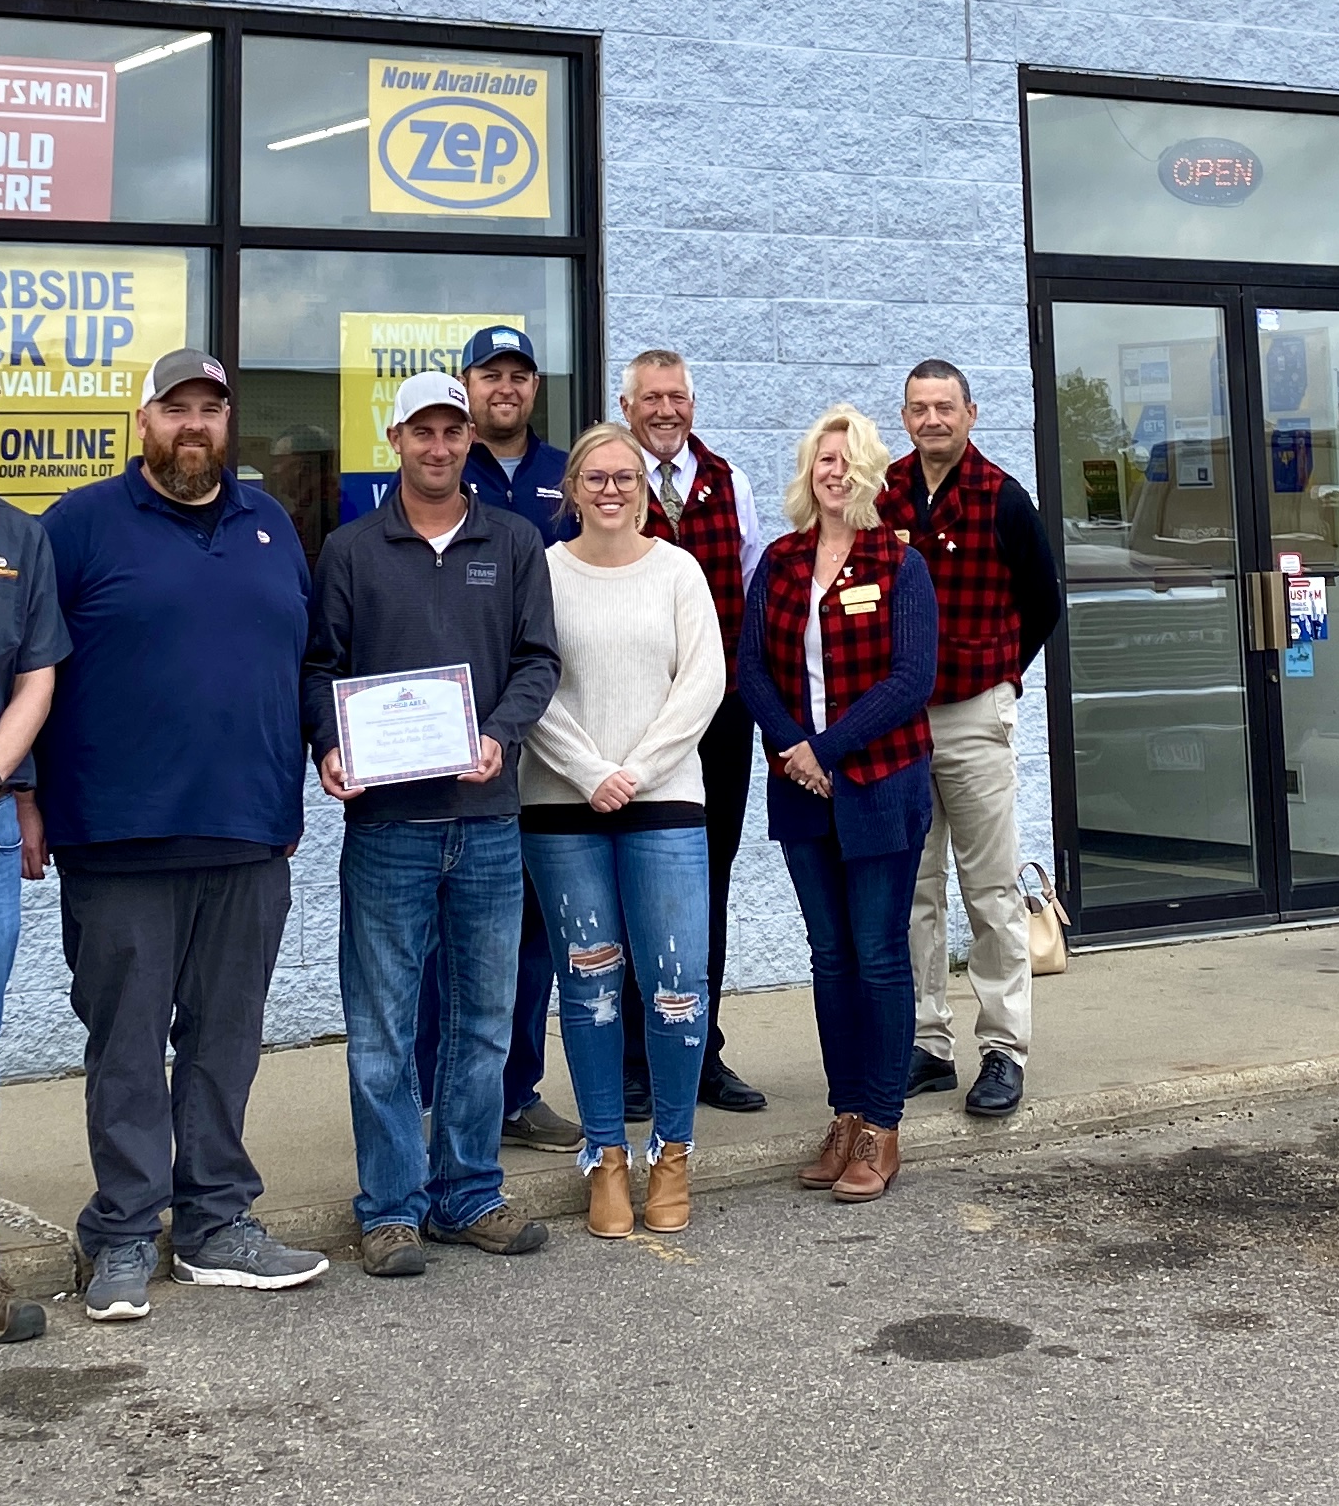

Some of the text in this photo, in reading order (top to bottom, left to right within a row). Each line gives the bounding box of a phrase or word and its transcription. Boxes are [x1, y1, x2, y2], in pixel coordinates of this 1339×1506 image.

[381, 66, 537, 96] Now Available
[1173, 157, 1253, 186] OPEN
[64, 315, 134, 367] UP
[371, 322, 478, 346] KNOWLED
[0, 429, 116, 461] ONLINE
[0, 464, 26, 478] OUR
[29, 464, 88, 477] PARKING
[91, 463, 115, 477] LOT
[469, 568, 495, 577] RMS
